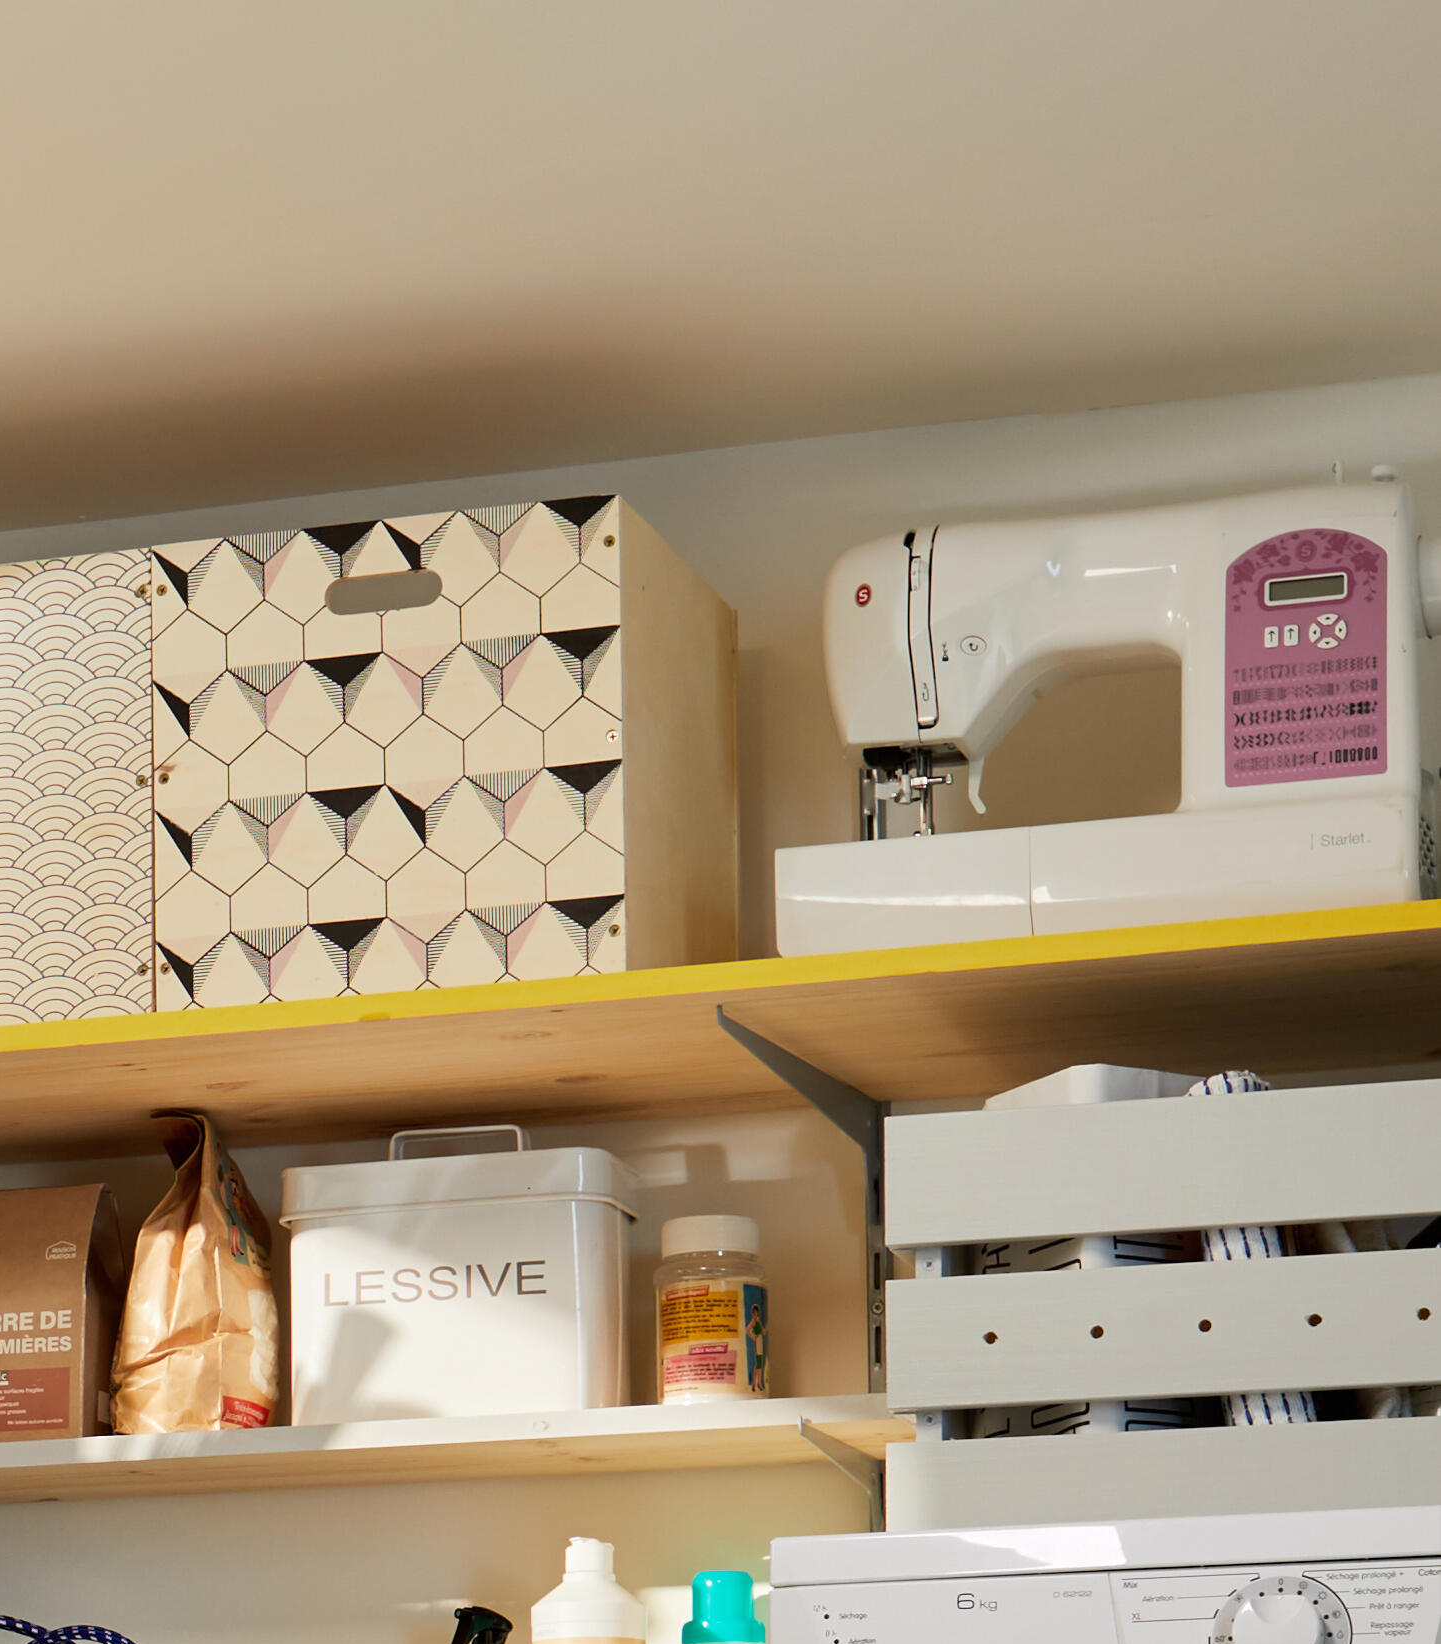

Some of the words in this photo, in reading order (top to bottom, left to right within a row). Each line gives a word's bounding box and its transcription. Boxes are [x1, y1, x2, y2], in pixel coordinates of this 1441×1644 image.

[858, 588, 869, 602] S
[1320, 832, 1365, 848] Starlet
[323, 1259, 548, 1307] LESSIVE
[40, 1309, 72, 1330] DE
[956, 1592, 975, 1610] 6
[979, 1600, 998, 1611] kg
